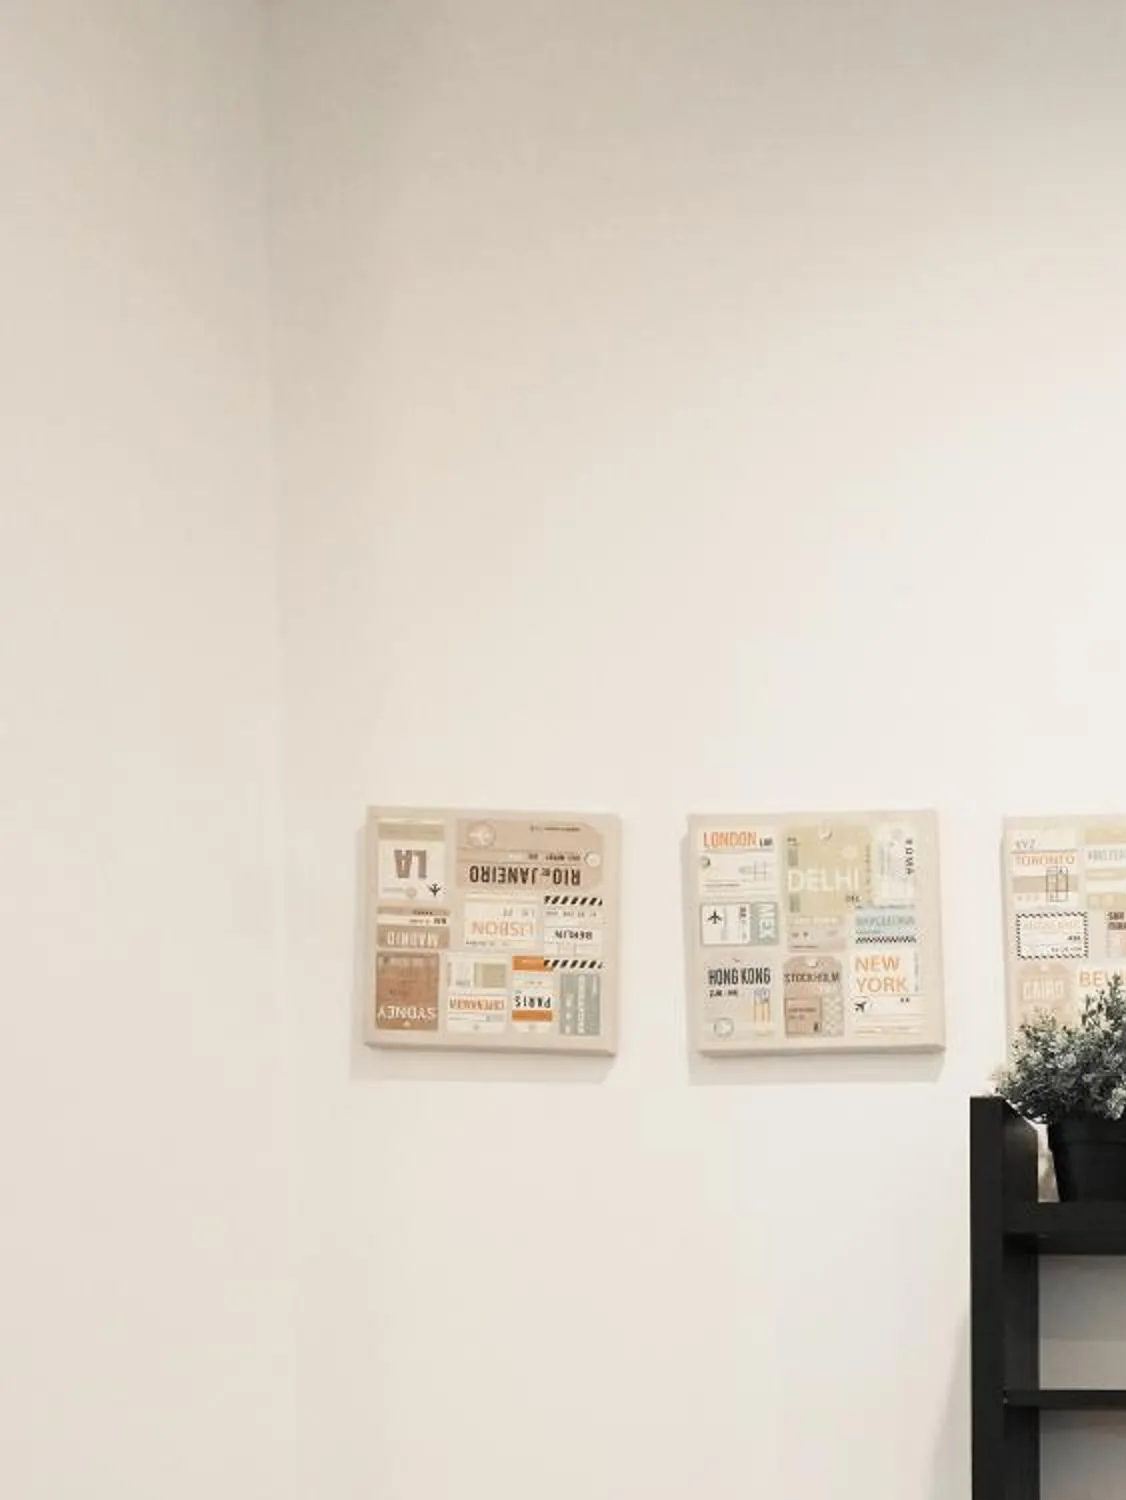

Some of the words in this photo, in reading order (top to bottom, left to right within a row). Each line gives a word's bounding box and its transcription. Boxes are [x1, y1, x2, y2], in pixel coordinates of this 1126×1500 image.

[704, 832, 756, 848] LONDON
[393, 849, 428, 880] LA
[469, 865, 538, 886] JANEIRO
[553, 867, 581, 886] RIO
[789, 869, 859, 892] DELHI
[471, 921, 538, 938] LISBON
[554, 930, 593, 941] BERLIN
[855, 956, 900, 972] NEW
[708, 967, 739, 986] HONG
[741, 967, 771, 985] KONG
[855, 977, 908, 993] YORK
[515, 995, 552, 1010] PARIS
[377, 1004, 438, 1022] SYDNEY
